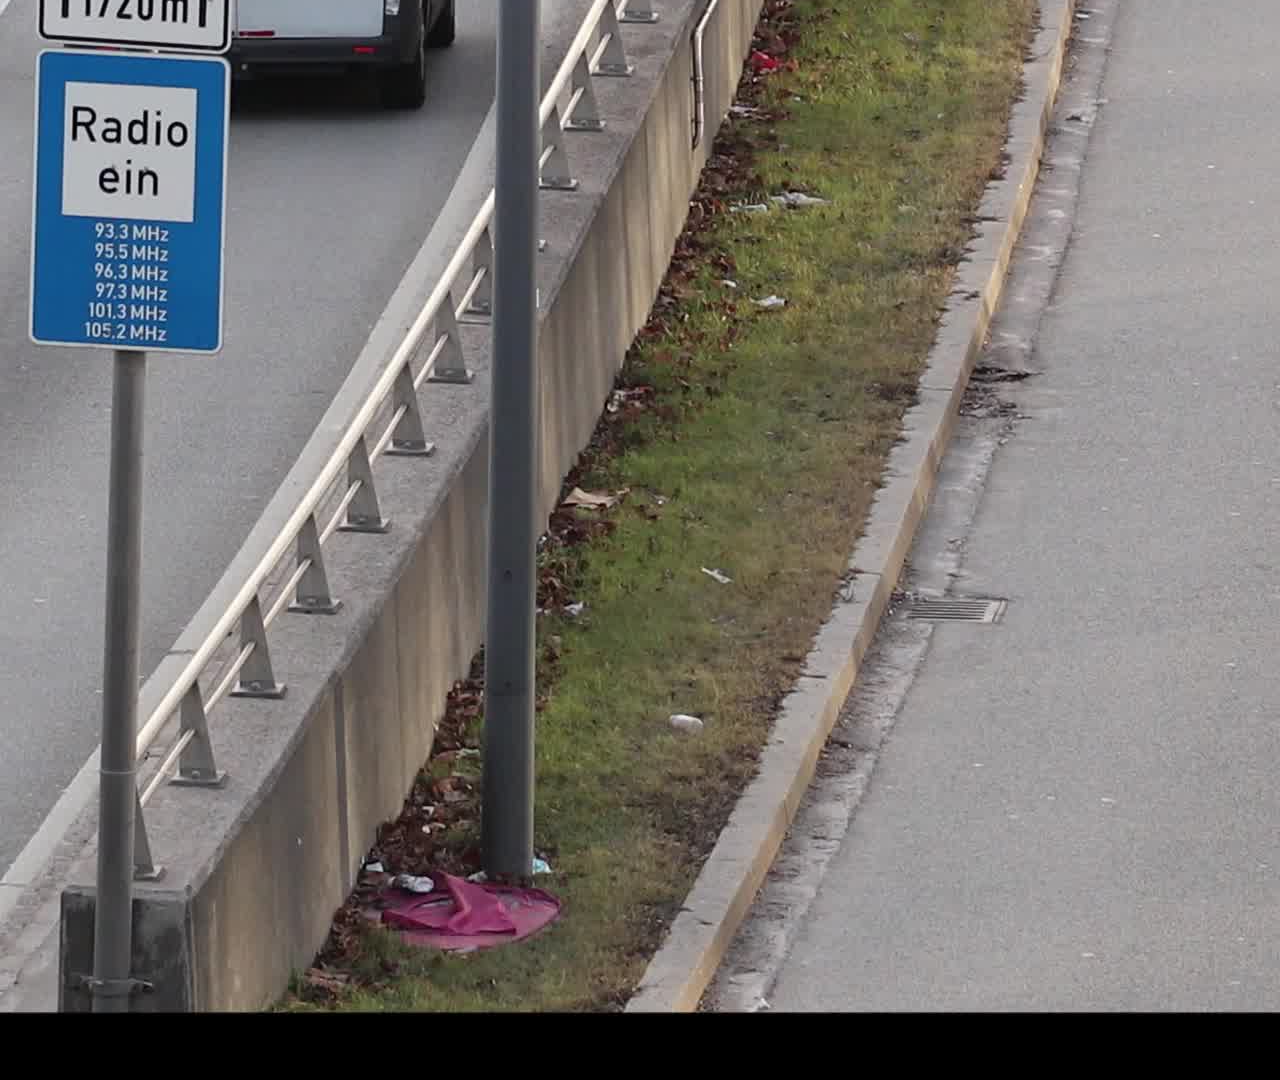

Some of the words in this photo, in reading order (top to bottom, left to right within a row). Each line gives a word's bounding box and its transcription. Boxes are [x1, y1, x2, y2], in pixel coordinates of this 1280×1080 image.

[72, 105, 188, 148] Radio
[98, 160, 159, 196] ein
[95, 223, 129, 240] 93.3
[132, 226, 169, 242] MHz
[95, 244, 129, 260] 95.5
[132, 246, 169, 262] MHz
[95, 263, 127, 280] 96.3
[131, 265, 168, 281] MHz
[95, 283, 128, 300] 97.3
[131, 285, 168, 302] MHz
[88, 302, 127, 320] 101.3
[130, 305, 167, 322] MHz
[85, 322, 126, 339] 105.2
[130, 325, 167, 342] MHz
